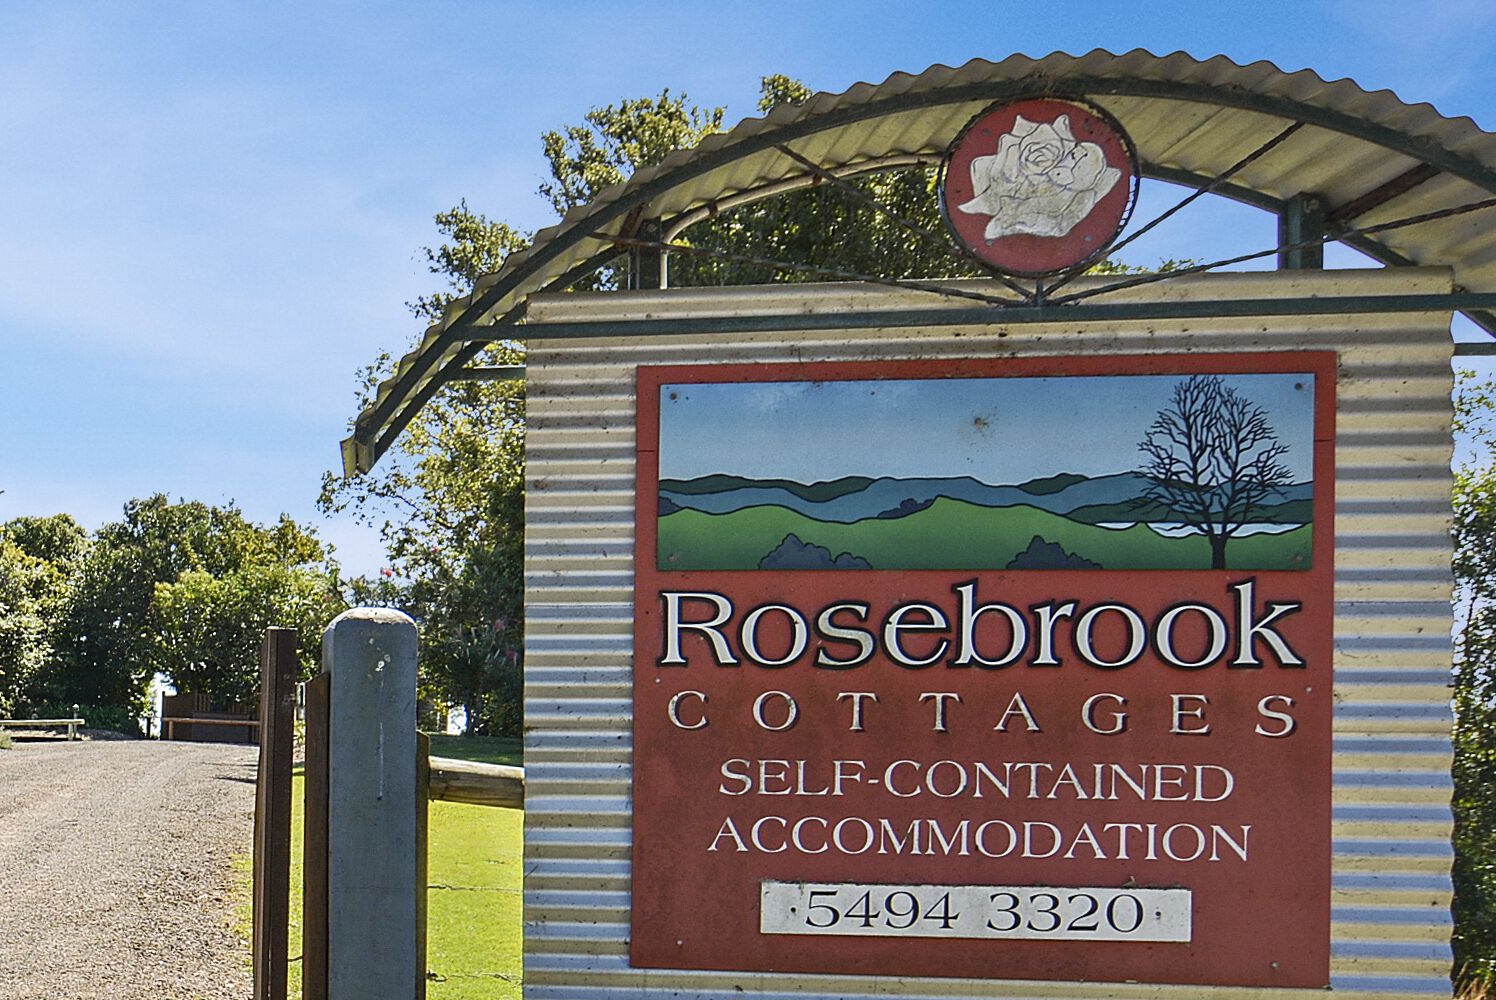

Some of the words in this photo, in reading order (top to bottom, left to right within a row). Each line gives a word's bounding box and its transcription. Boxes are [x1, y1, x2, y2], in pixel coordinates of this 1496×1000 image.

[657, 577, 1306, 670] Rosebrook
[667, 690, 1298, 738] COTTAGES
[718, 758, 1235, 802] SELF-CONTAINED
[707, 815, 1252, 863] ACCOMMODATION
[805, 889, 960, 930] 5494
[986, 892, 1144, 933] 3320
